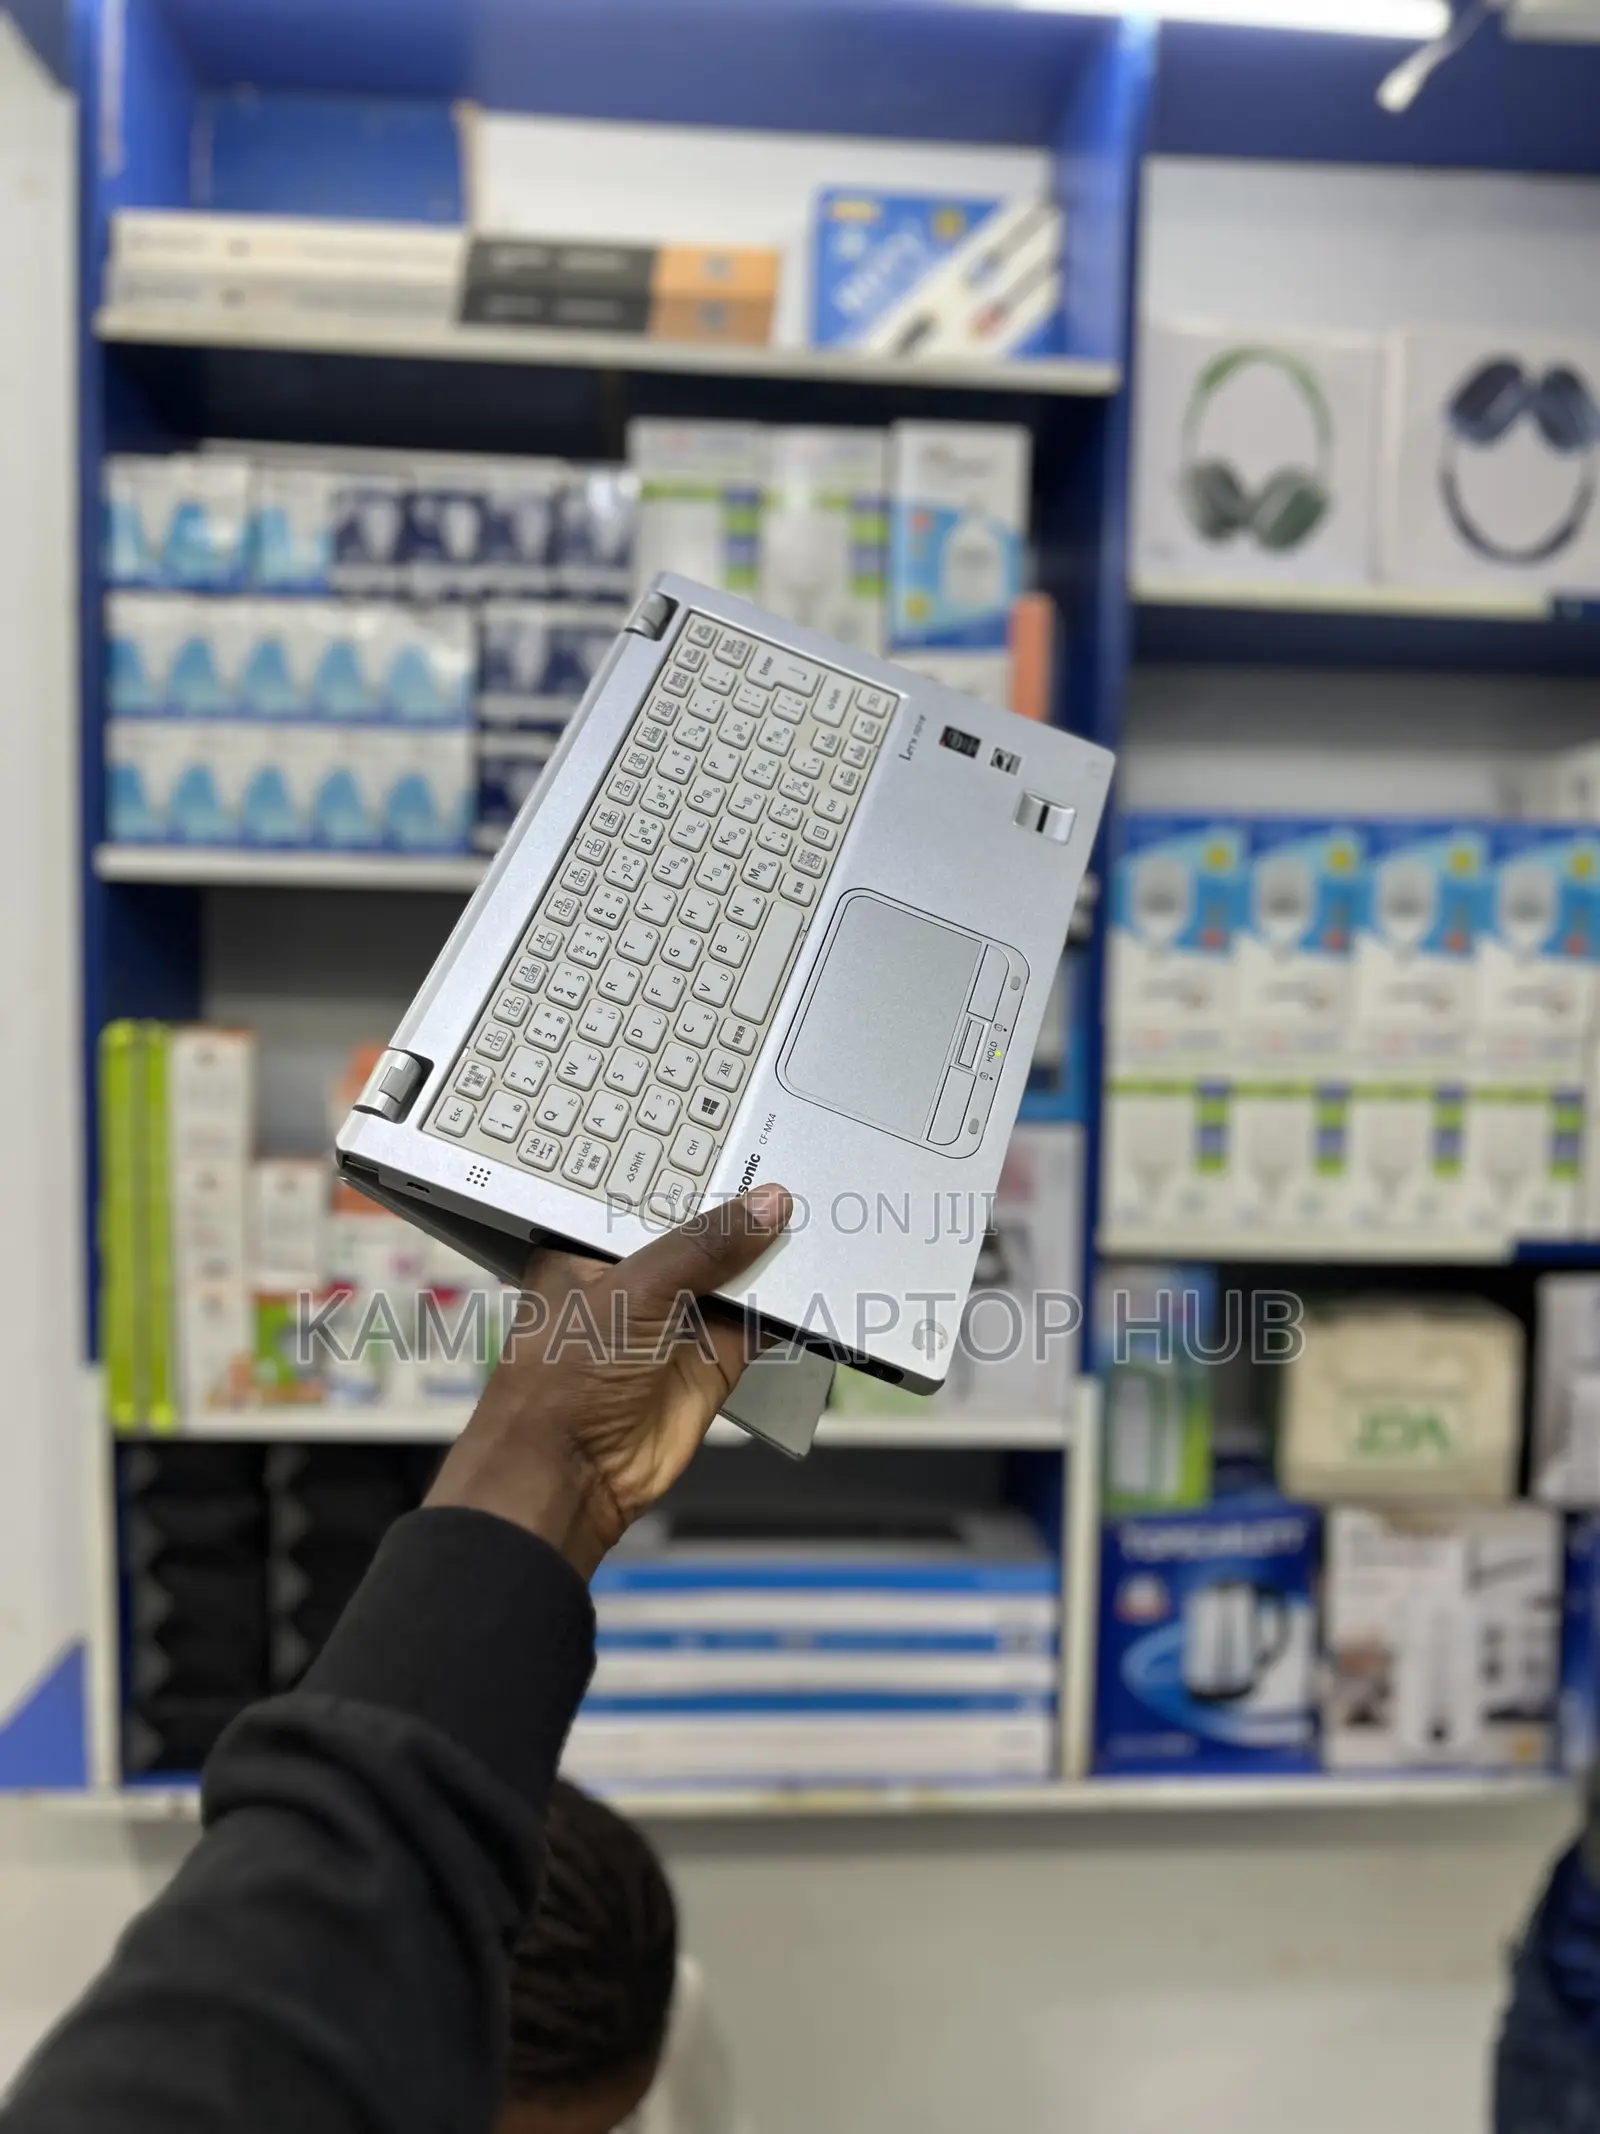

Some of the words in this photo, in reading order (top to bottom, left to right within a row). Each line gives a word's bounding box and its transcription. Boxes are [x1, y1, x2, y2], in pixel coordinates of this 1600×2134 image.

[826, 799, 837, 812] Ctrl
[748, 867, 761, 880] M
[685, 909, 697, 920] H
[732, 905, 745, 916] N
[631, 1028, 643, 1039] D
[986, 1041, 998, 1063] HOLD
[563, 1061, 579, 1075] W
[663, 1065, 676, 1077] X
[718, 1060, 733, 1078] Alt
[449, 1107, 463, 1122] Esc
[543, 1110, 558, 1121] Q
[644, 1110, 657, 1121] Z
[592, 1117, 605, 1128] A
[525, 1138, 541, 1154] Tab
[577, 1141, 593, 1158] Lock
[686, 1139, 699, 1156] Ctrl
[629, 1151, 646, 1173] Shift
[735, 1153, 761, 1198] sonic
[758, 1113, 776, 1145] CF-MX4
[570, 1157, 585, 1175] Caps
